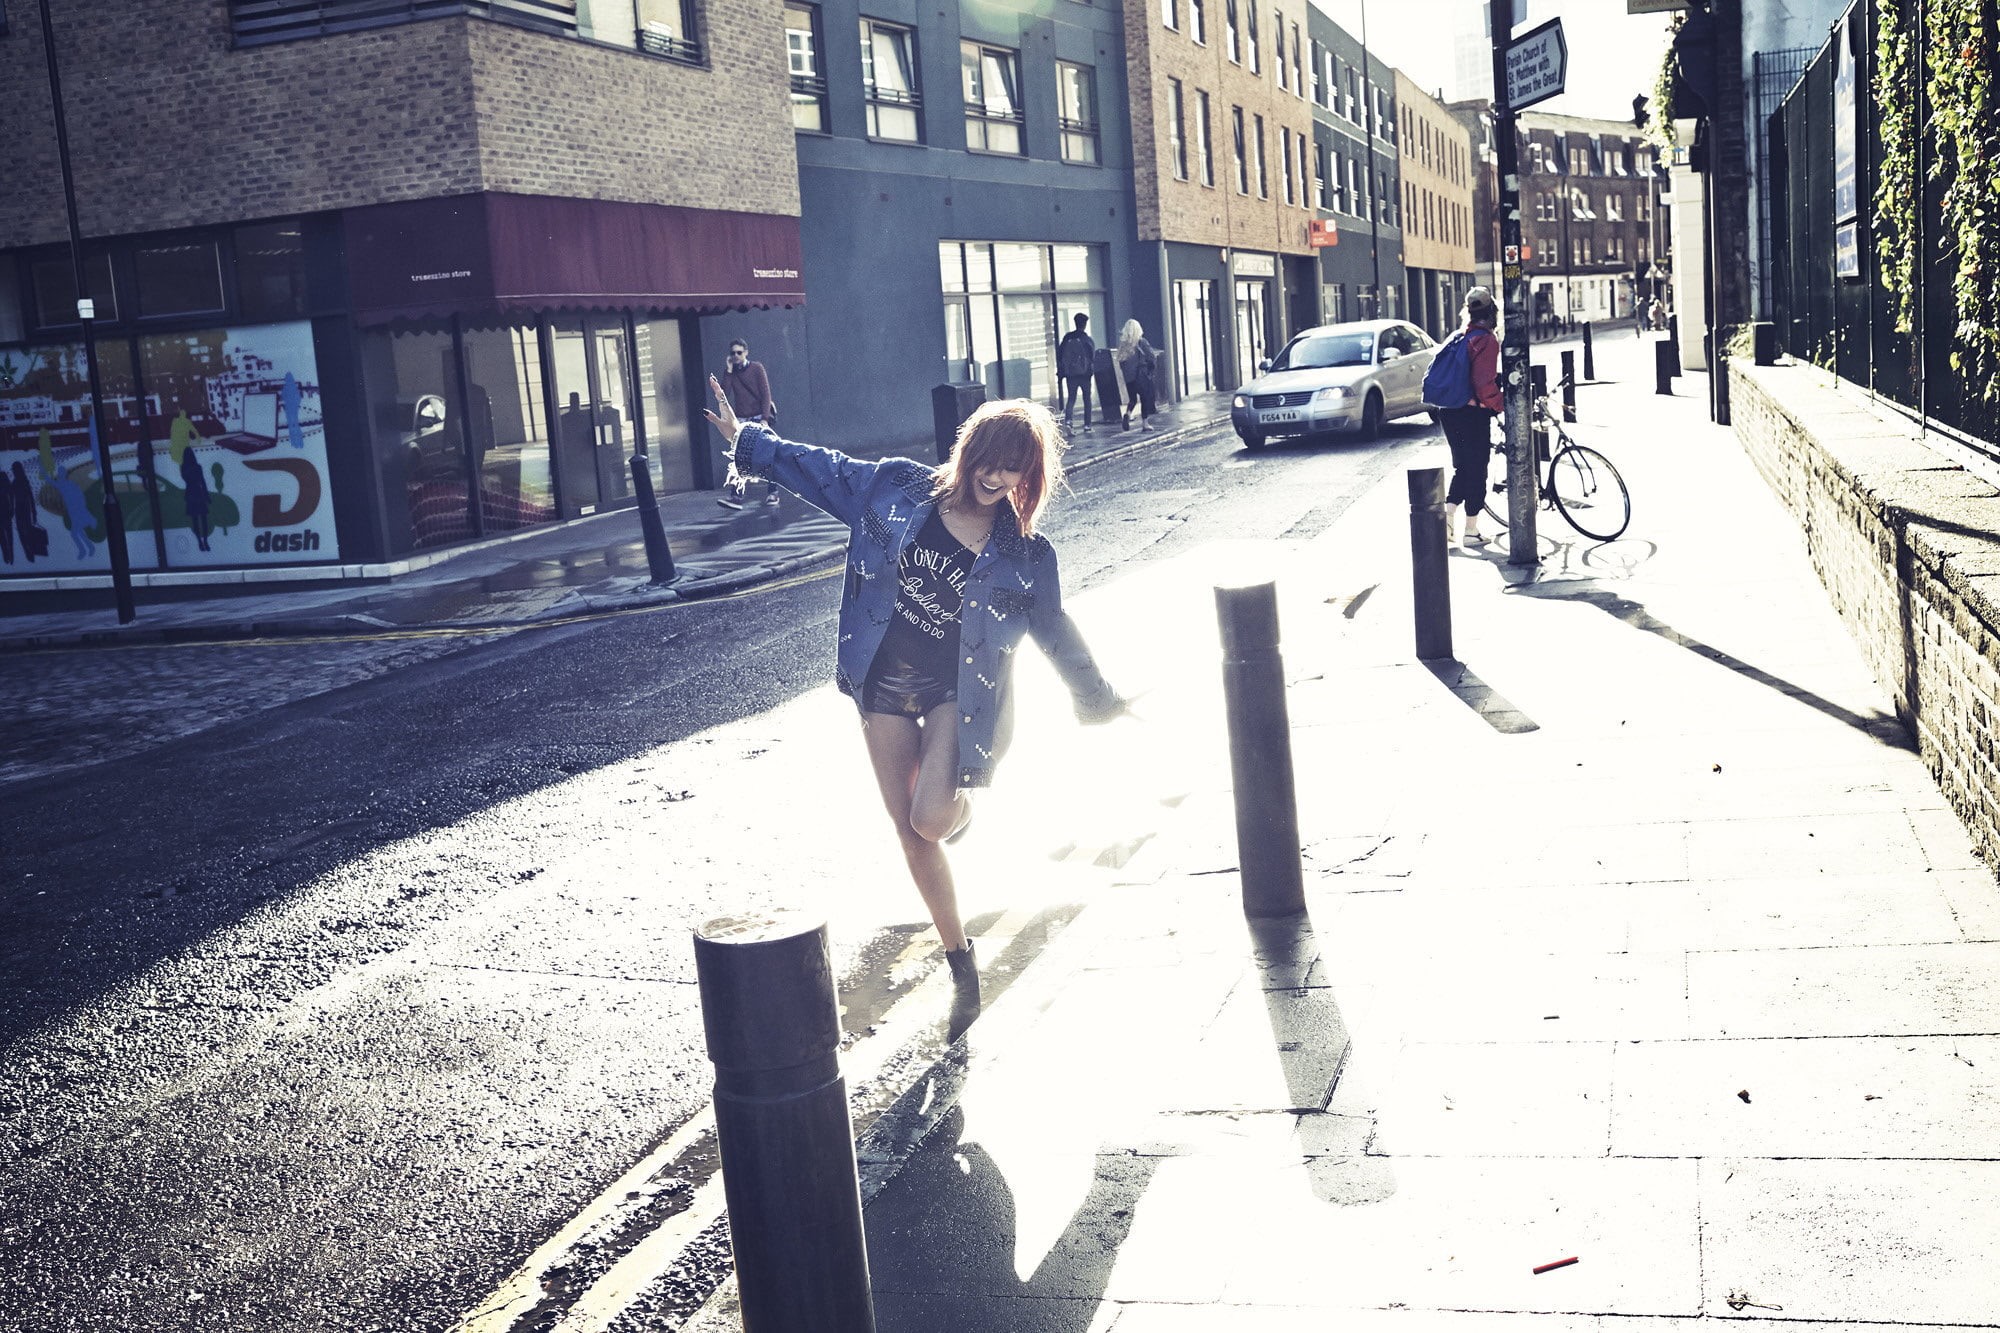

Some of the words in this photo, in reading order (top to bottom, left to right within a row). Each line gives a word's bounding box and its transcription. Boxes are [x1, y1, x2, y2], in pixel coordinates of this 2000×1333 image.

[1508, 51, 1522, 69] Parish
[1523, 42, 1540, 63] Church
[1541, 38, 1547, 54] of
[1516, 63, 1538, 81] Matthew
[1538, 54, 1551, 72] with
[1517, 82, 1532, 98] James
[1532, 76, 1542, 92] the
[1542, 68, 1558, 87] Great
[451, 270, 472, 278] store
[783, 268, 799, 279] store
[254, 529, 320, 553] dash
[914, 547, 952, 574] ONLY
[947, 566, 966, 597] HA
[902, 576, 959, 623] Believe
[901, 609, 920, 625] AND
[919, 619, 932, 633] TO
[930, 629, 945, 640] DO
